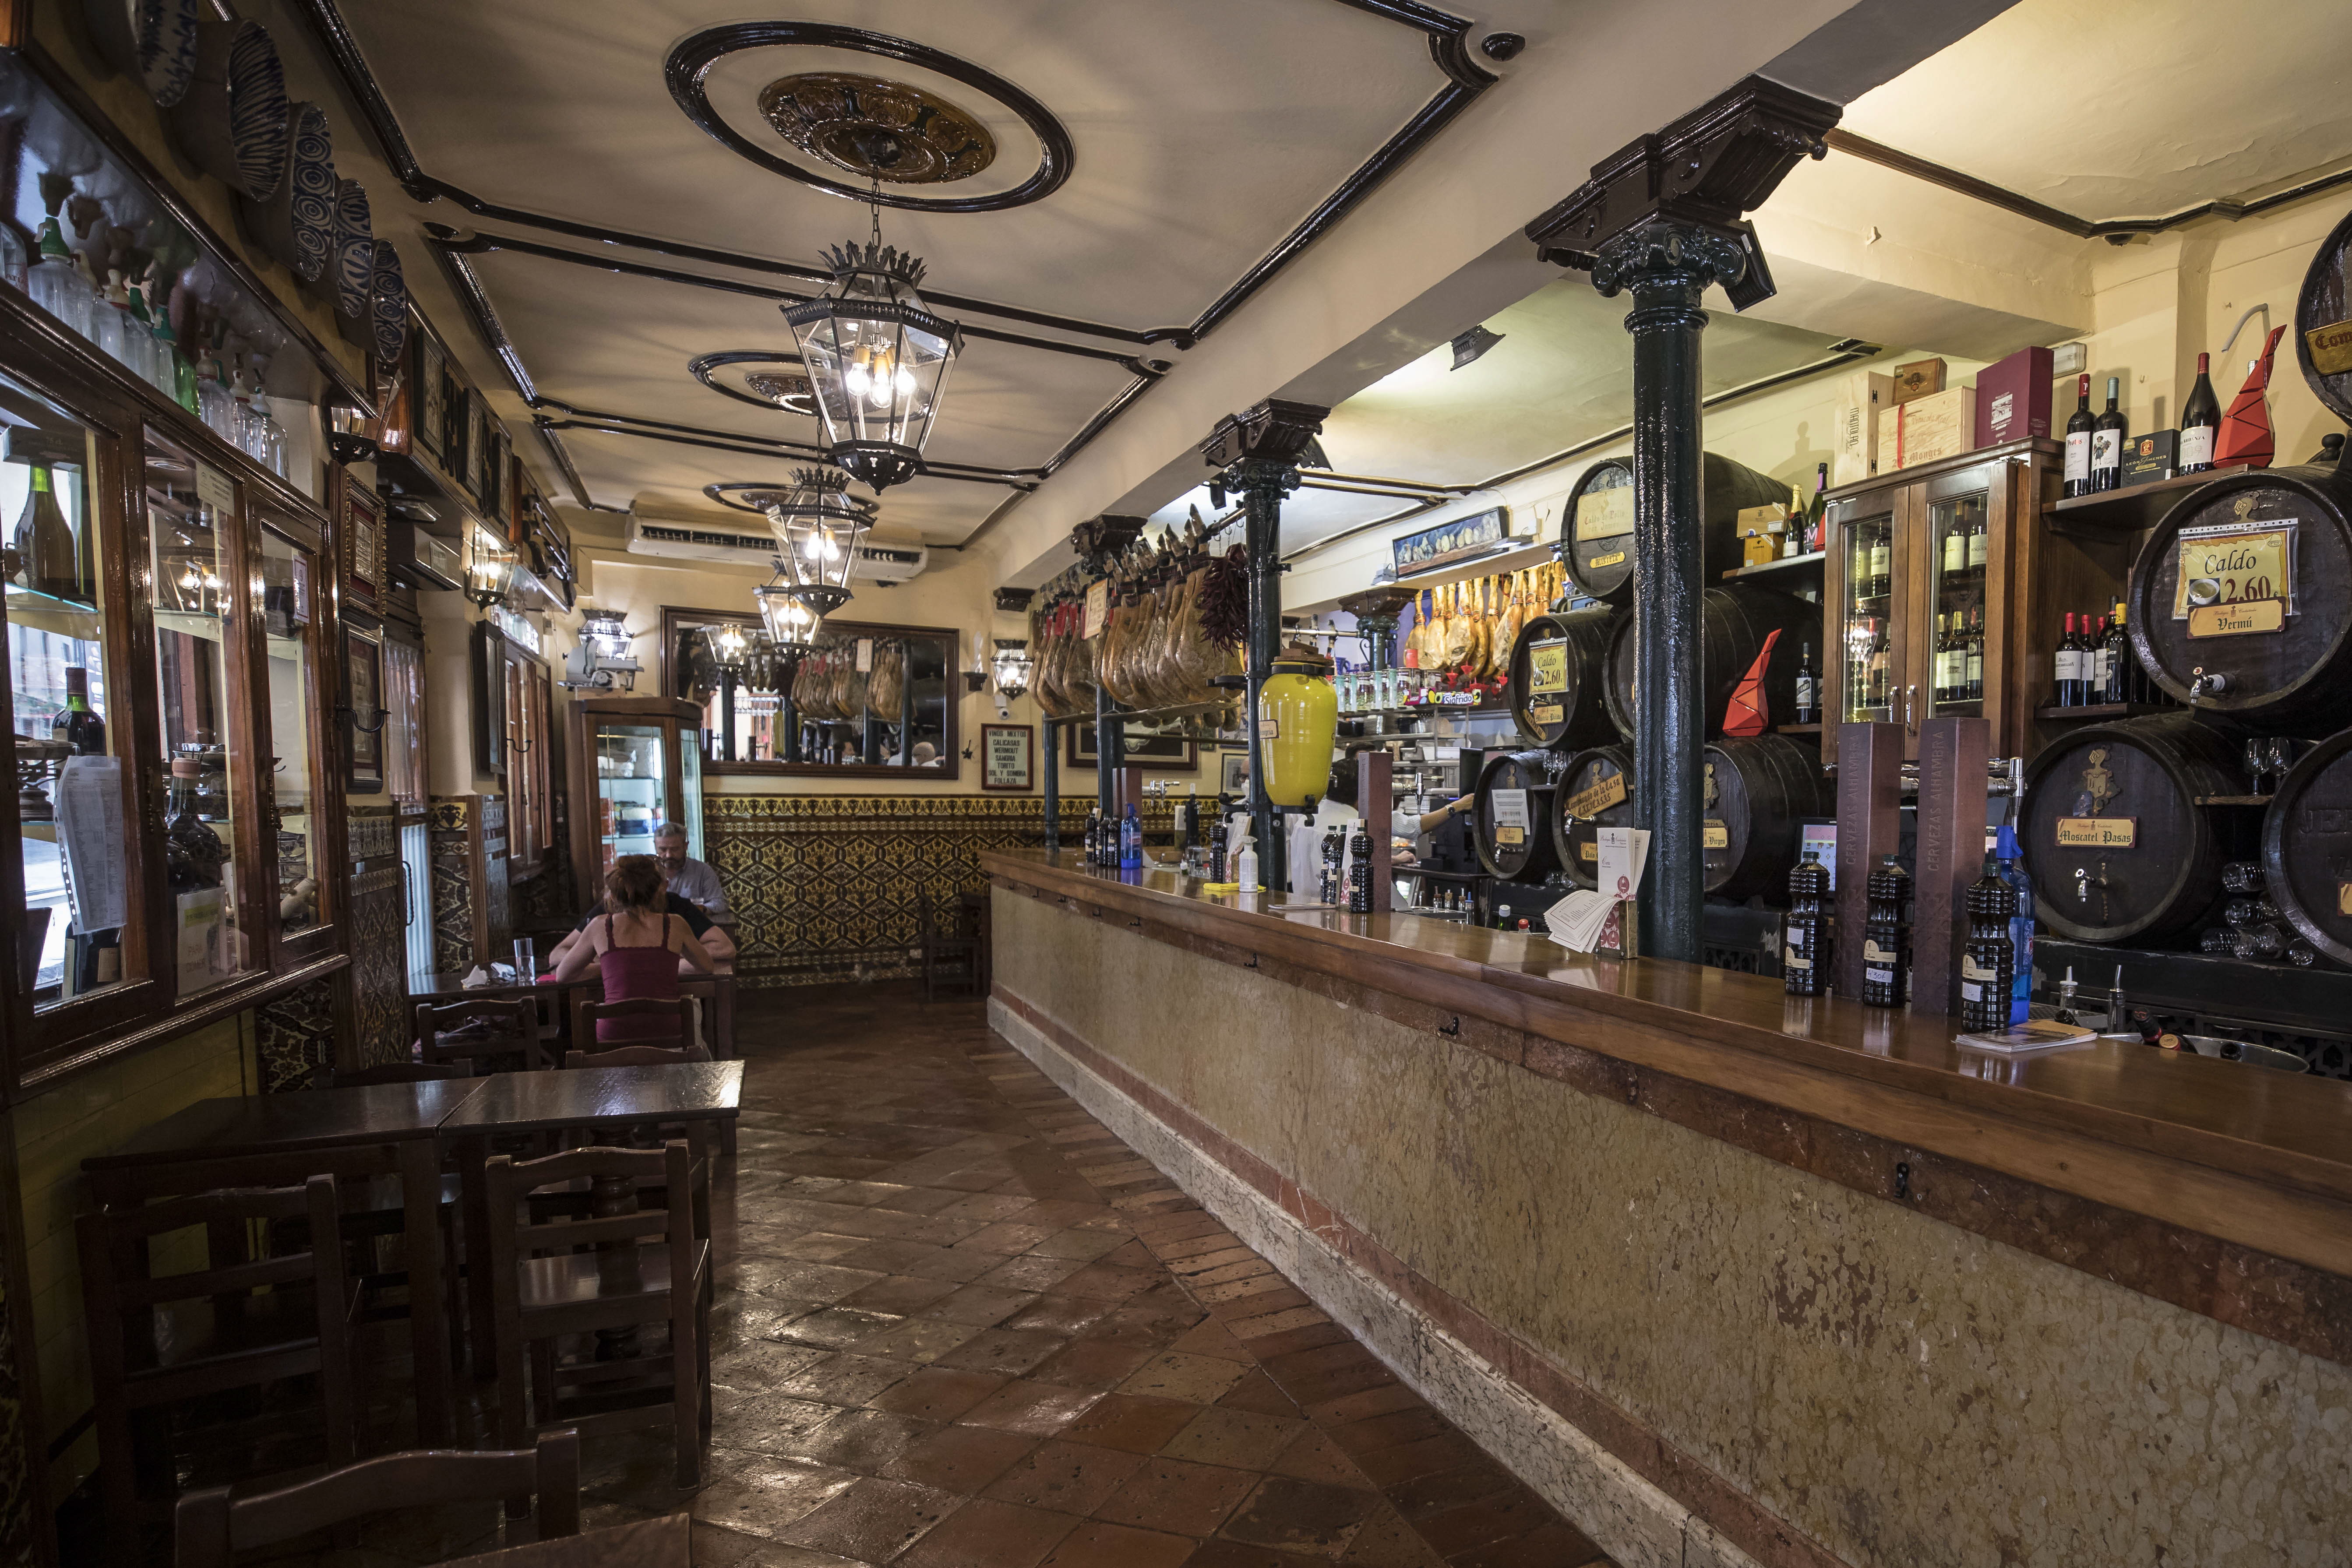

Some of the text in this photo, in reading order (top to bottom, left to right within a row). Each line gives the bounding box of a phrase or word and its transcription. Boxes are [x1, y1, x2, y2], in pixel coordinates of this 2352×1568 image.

[1908, 446, 1942, 465] Monges
[2204, 548, 2257, 574] Caldo
[2217, 616, 2252, 631] Vermú
[1537, 654, 1556, 669] Caldo
[1545, 669, 1561, 687] 2,60
[1709, 836, 1726, 846] Virgen
[2059, 830, 2132, 844] Moscatel Pasas
